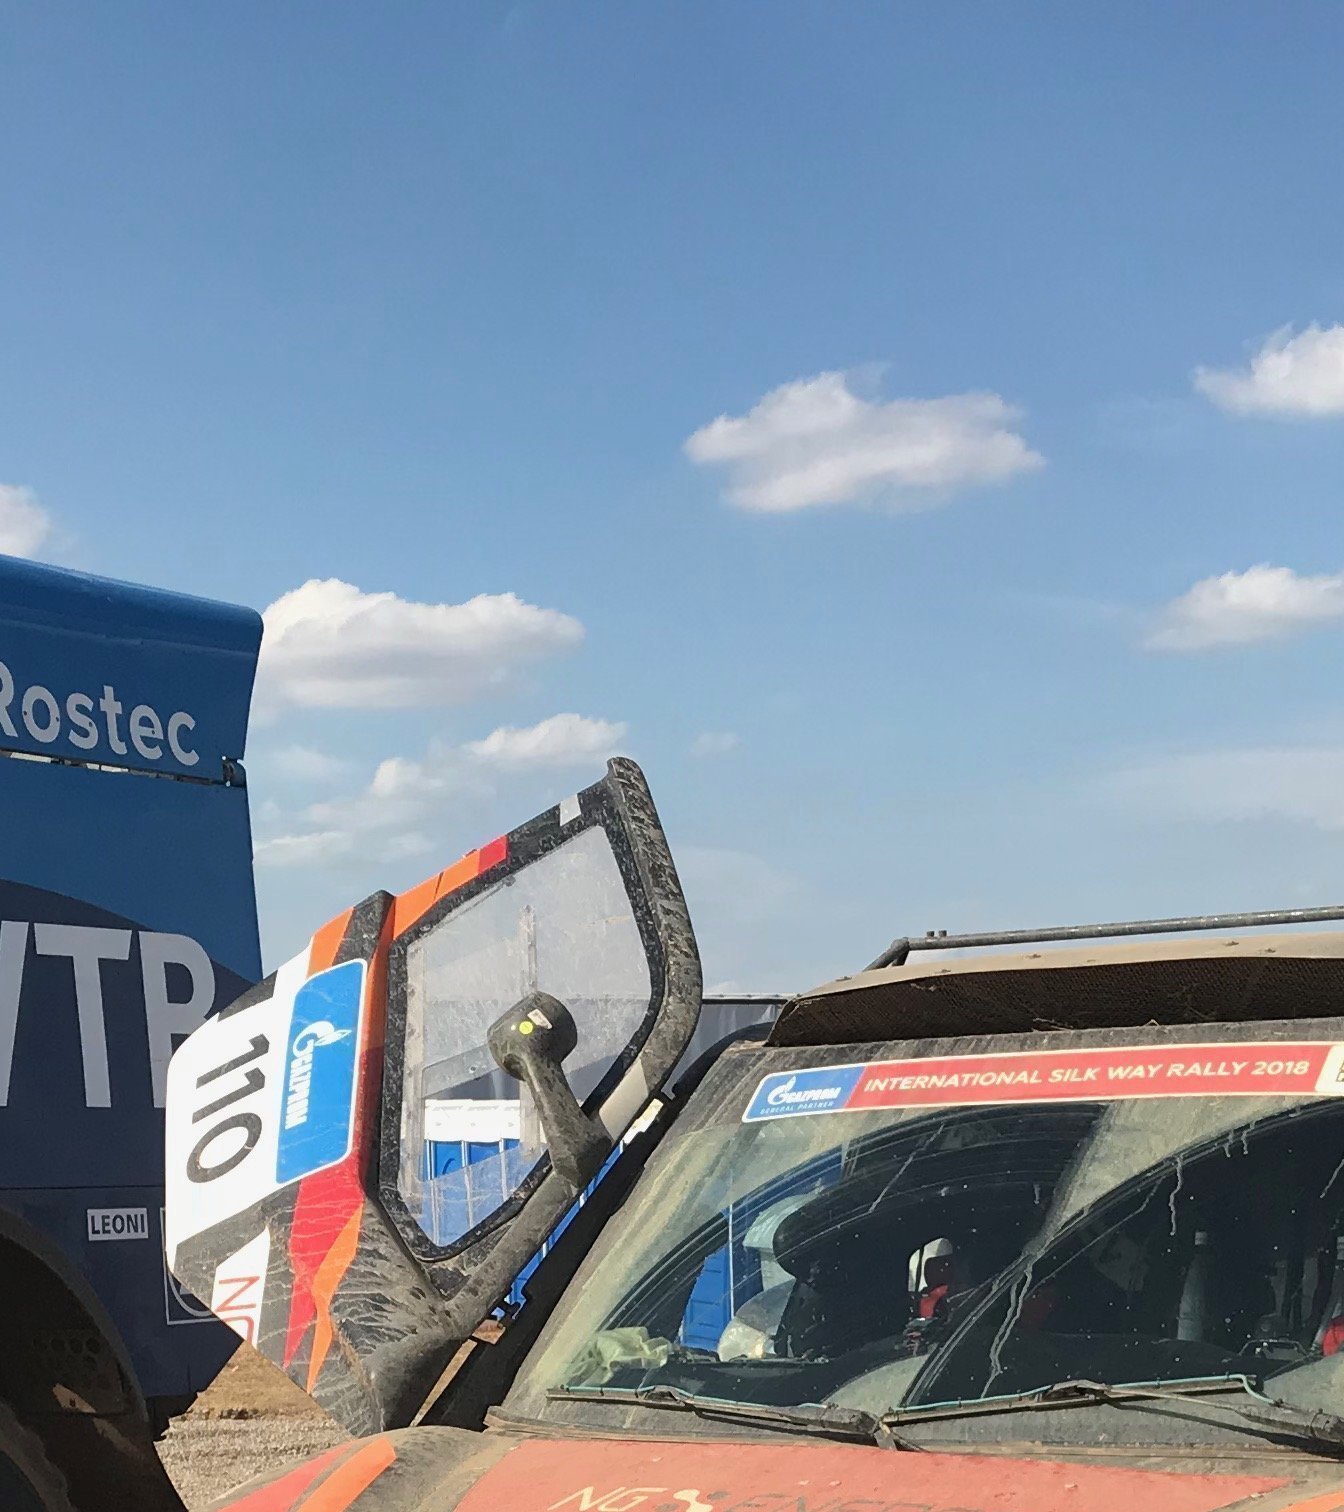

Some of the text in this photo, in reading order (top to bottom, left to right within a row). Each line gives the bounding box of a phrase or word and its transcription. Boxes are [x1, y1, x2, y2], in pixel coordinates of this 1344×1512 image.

[864, 1060, 1311, 1093] INTERNATIONAL SILK WAY RALLY 2018
[187, 1032, 270, 1183] 110
[91, 1212, 147, 1235] LEONI
[548, 1486, 667, 1512] NG
